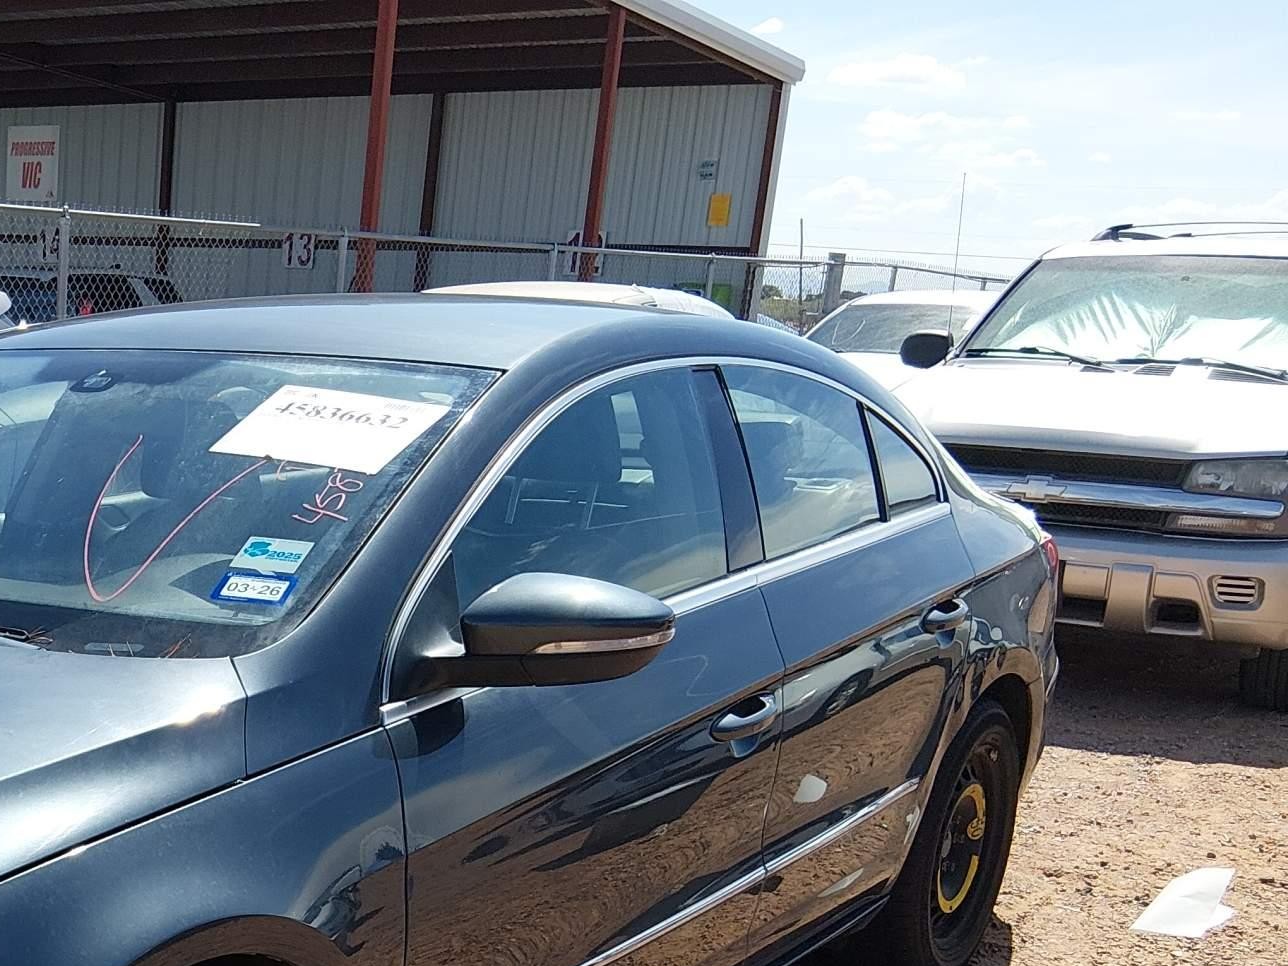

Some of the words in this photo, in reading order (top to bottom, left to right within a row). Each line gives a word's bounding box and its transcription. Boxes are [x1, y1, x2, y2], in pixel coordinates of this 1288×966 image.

[11, 142, 56, 156] PROGRESSIVE
[22, 161, 43, 189] VIC
[40, 227, 60, 261] 14
[284, 232, 312, 266] 13
[274, 401, 409, 429] 45836632
[266, 550, 304, 560] 2025
